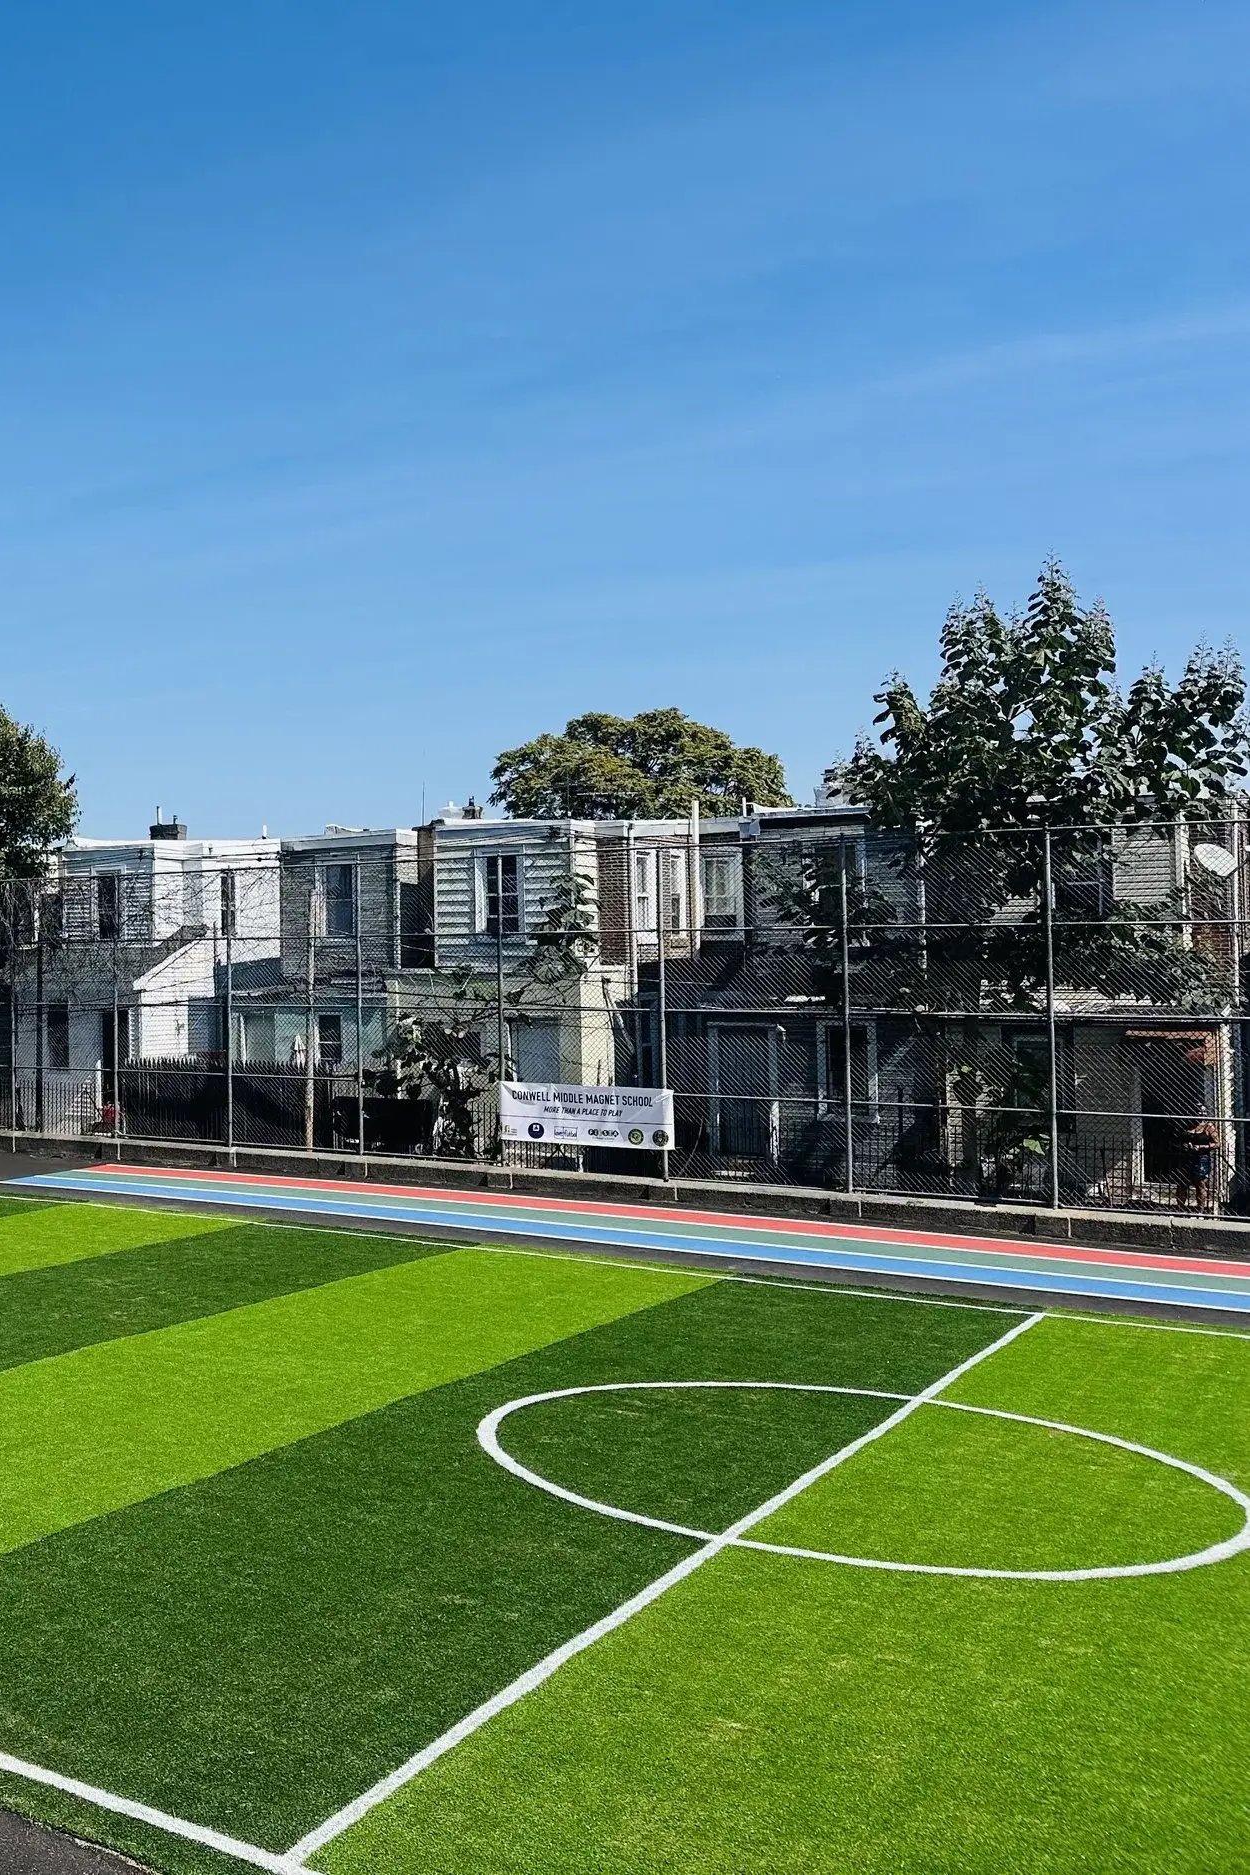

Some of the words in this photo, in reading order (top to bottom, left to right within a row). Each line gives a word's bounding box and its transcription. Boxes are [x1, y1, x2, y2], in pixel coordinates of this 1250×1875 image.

[512, 1090, 551, 1102] CONWELL
[553, 1092, 584, 1104] MIDDLE
[585, 1094, 620, 1105] MAGNET
[622, 1095, 653, 1107] SCHOOL
[543, 1105, 560, 1114] MORE
[561, 1106, 575, 1114] THAN
[575, 1107, 581, 1115] A
[581, 1108, 600, 1116] PLACE
[600, 1109, 608, 1117] TO
[608, 1109, 623, 1117] PLAY
